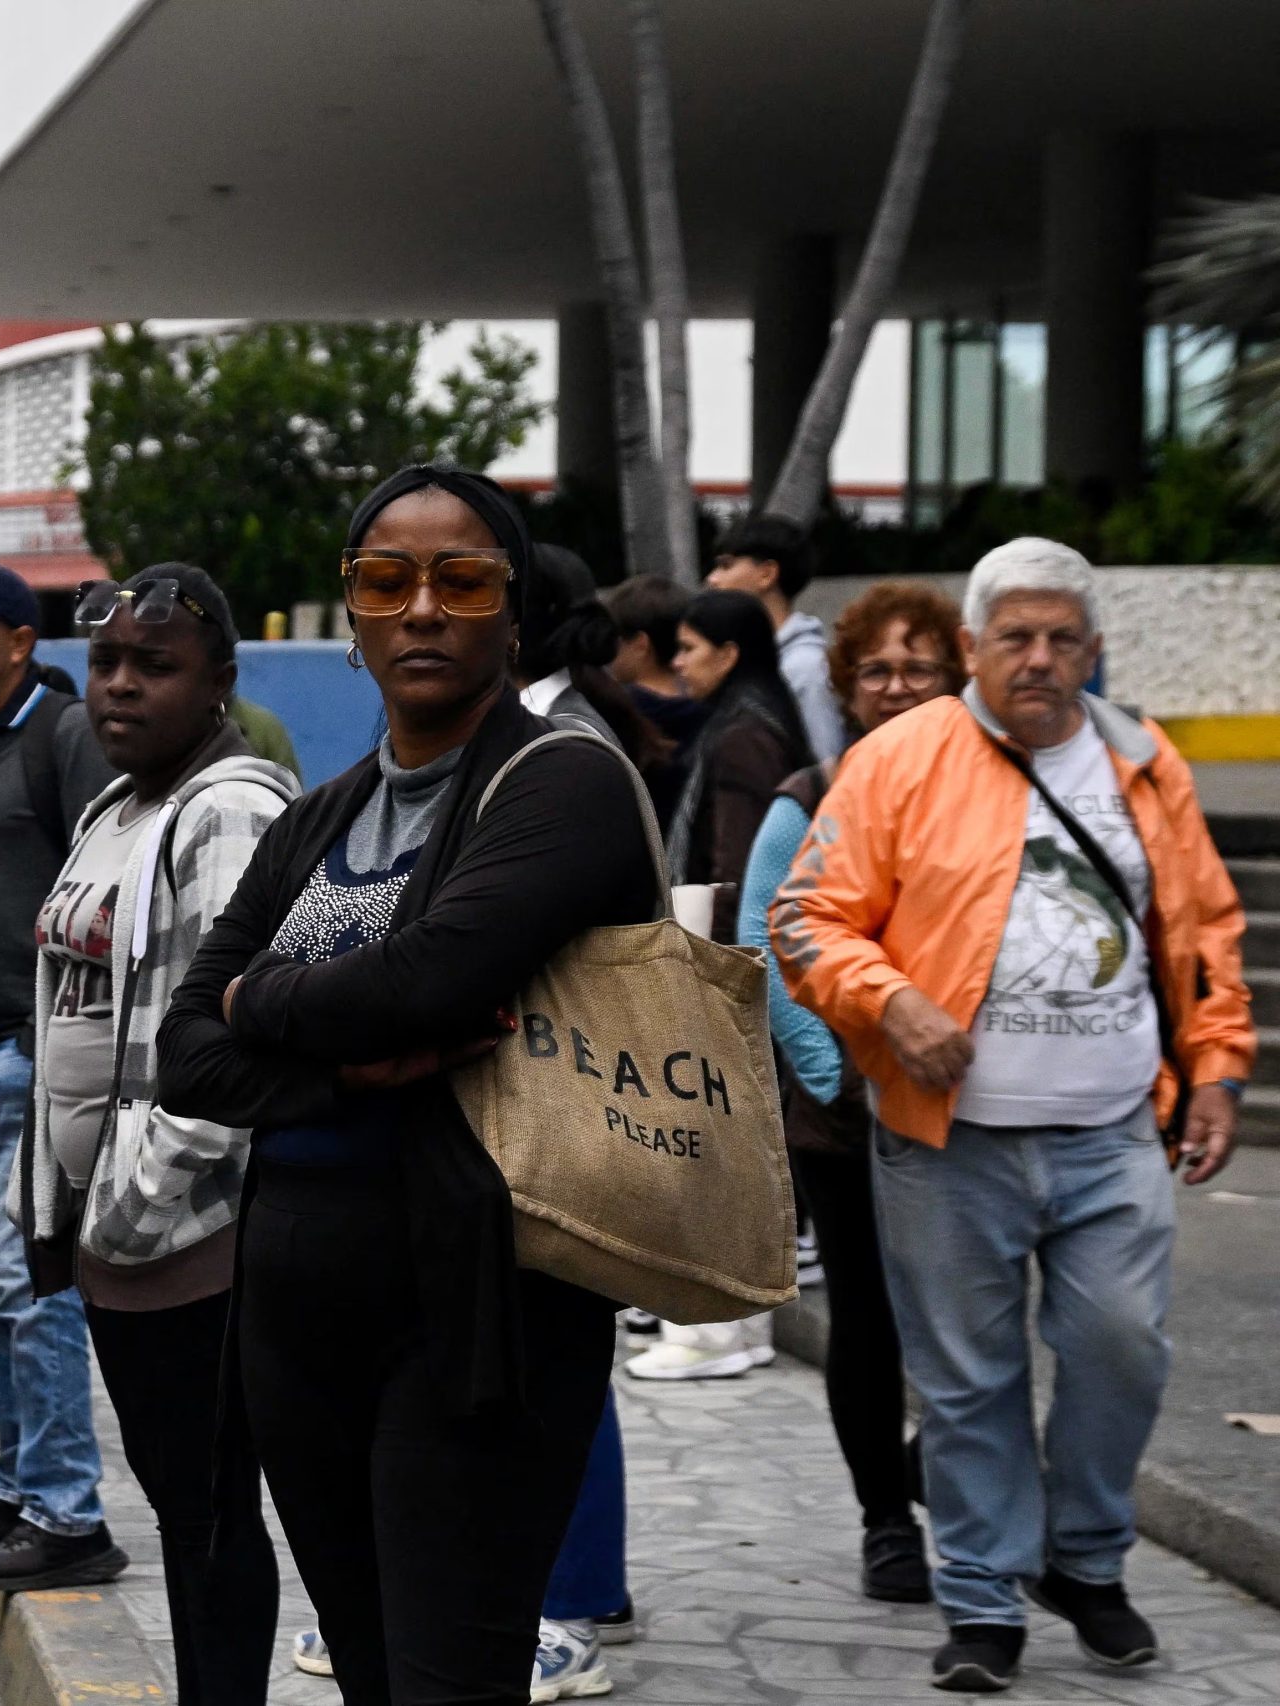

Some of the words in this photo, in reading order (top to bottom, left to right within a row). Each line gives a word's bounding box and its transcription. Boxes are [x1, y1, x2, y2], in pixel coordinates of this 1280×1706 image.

[984, 1010, 1108, 1036] FISHING
[522, 1012, 732, 1116] BEACH
[604, 1105, 702, 1159] PLEASE
